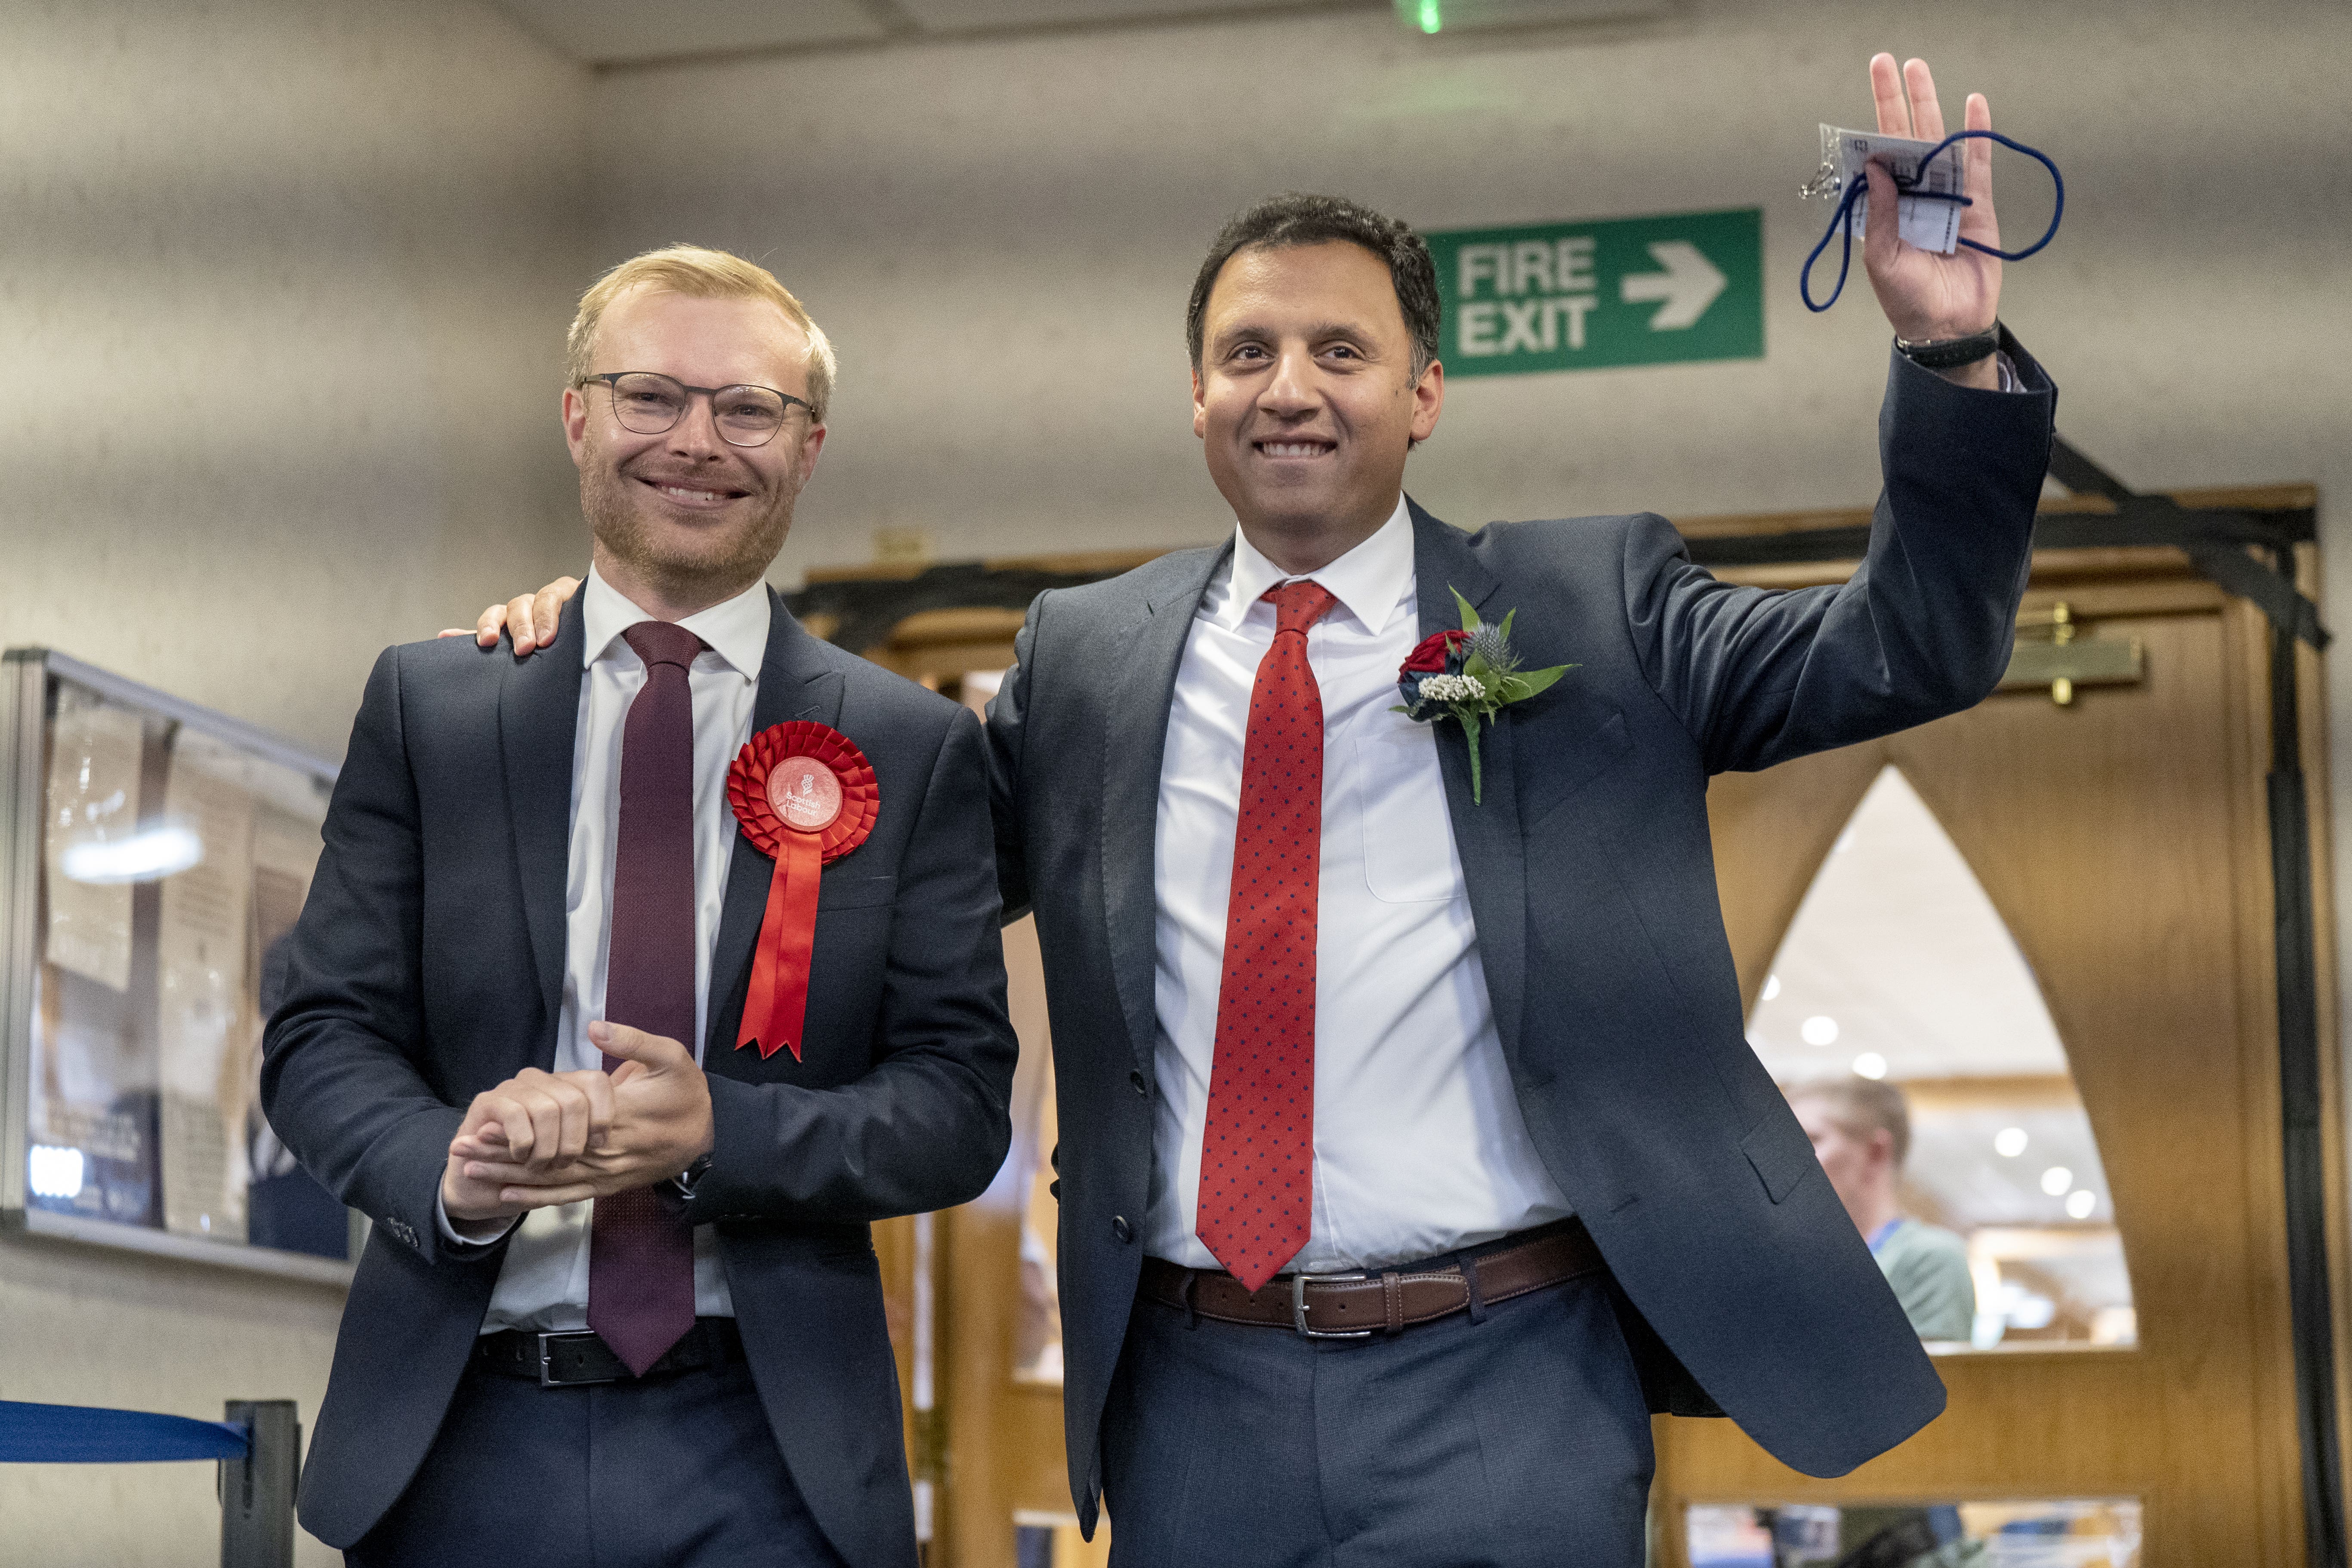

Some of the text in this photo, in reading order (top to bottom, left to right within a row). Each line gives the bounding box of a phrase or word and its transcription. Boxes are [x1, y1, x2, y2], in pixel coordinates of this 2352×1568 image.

[1459, 238, 1596, 297] FIRE
[1459, 296, 1597, 355] EXIT
[787, 792, 820, 809] Scottish
[787, 800, 817, 816] Labour
